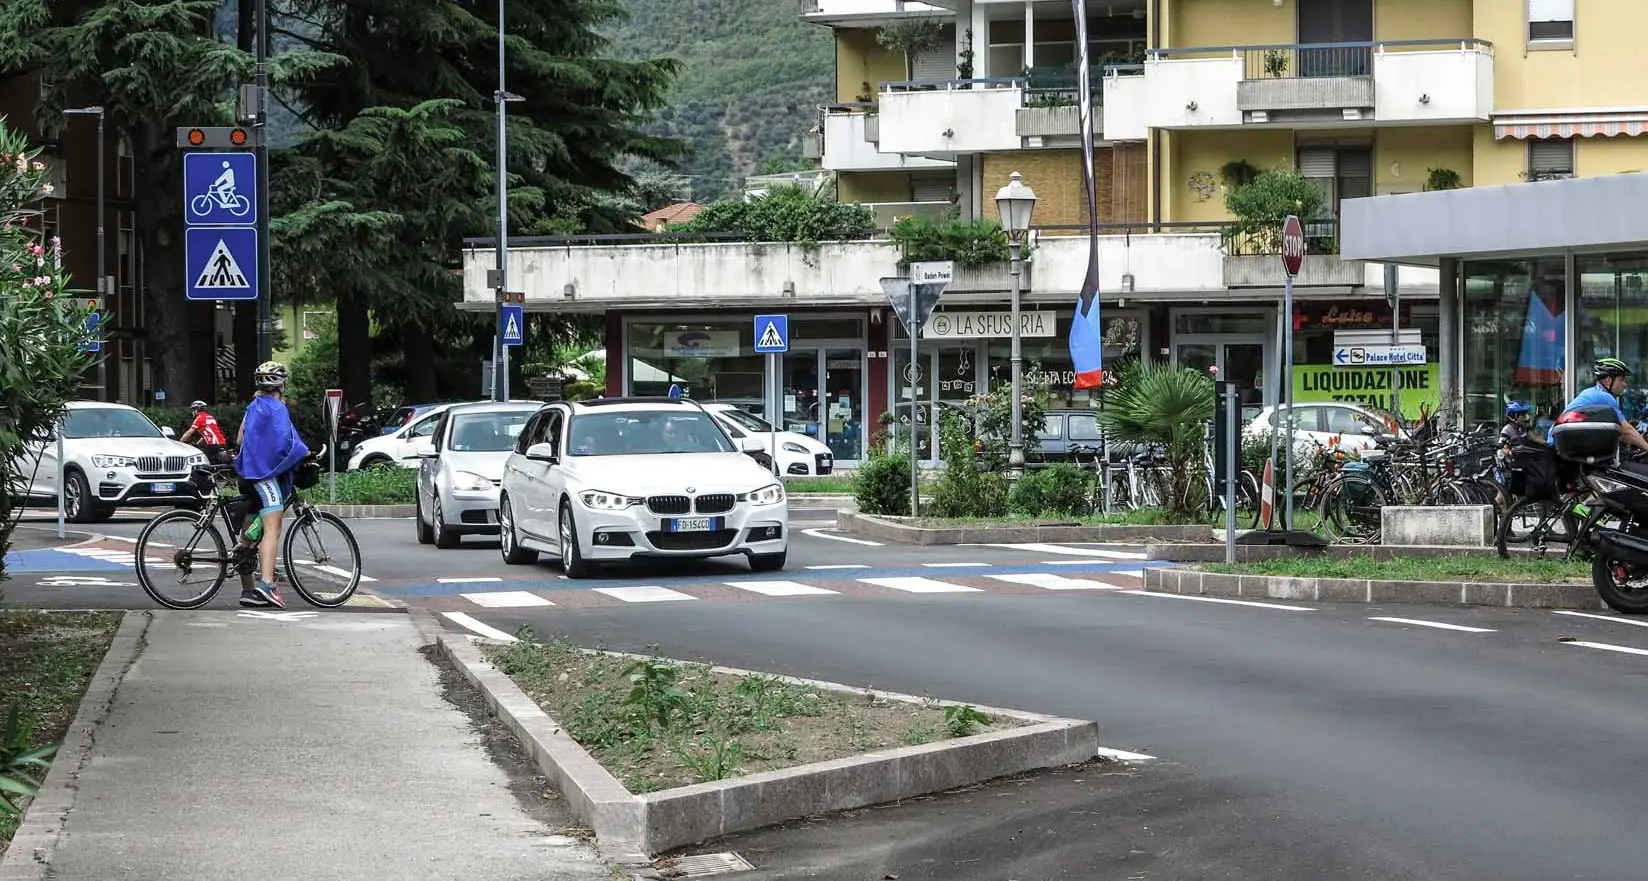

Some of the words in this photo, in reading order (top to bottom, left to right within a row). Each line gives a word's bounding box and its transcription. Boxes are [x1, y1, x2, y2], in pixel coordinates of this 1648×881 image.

[1284, 235, 1302, 258] STOP
[956, 315, 973, 335] LA
[977, 314, 1044, 335] SFUSRIA
[1366, 353, 1388, 361] Palace
[1388, 352, 1406, 361] Hotel
[1303, 370, 1429, 392] LIQUIDAZIONE
